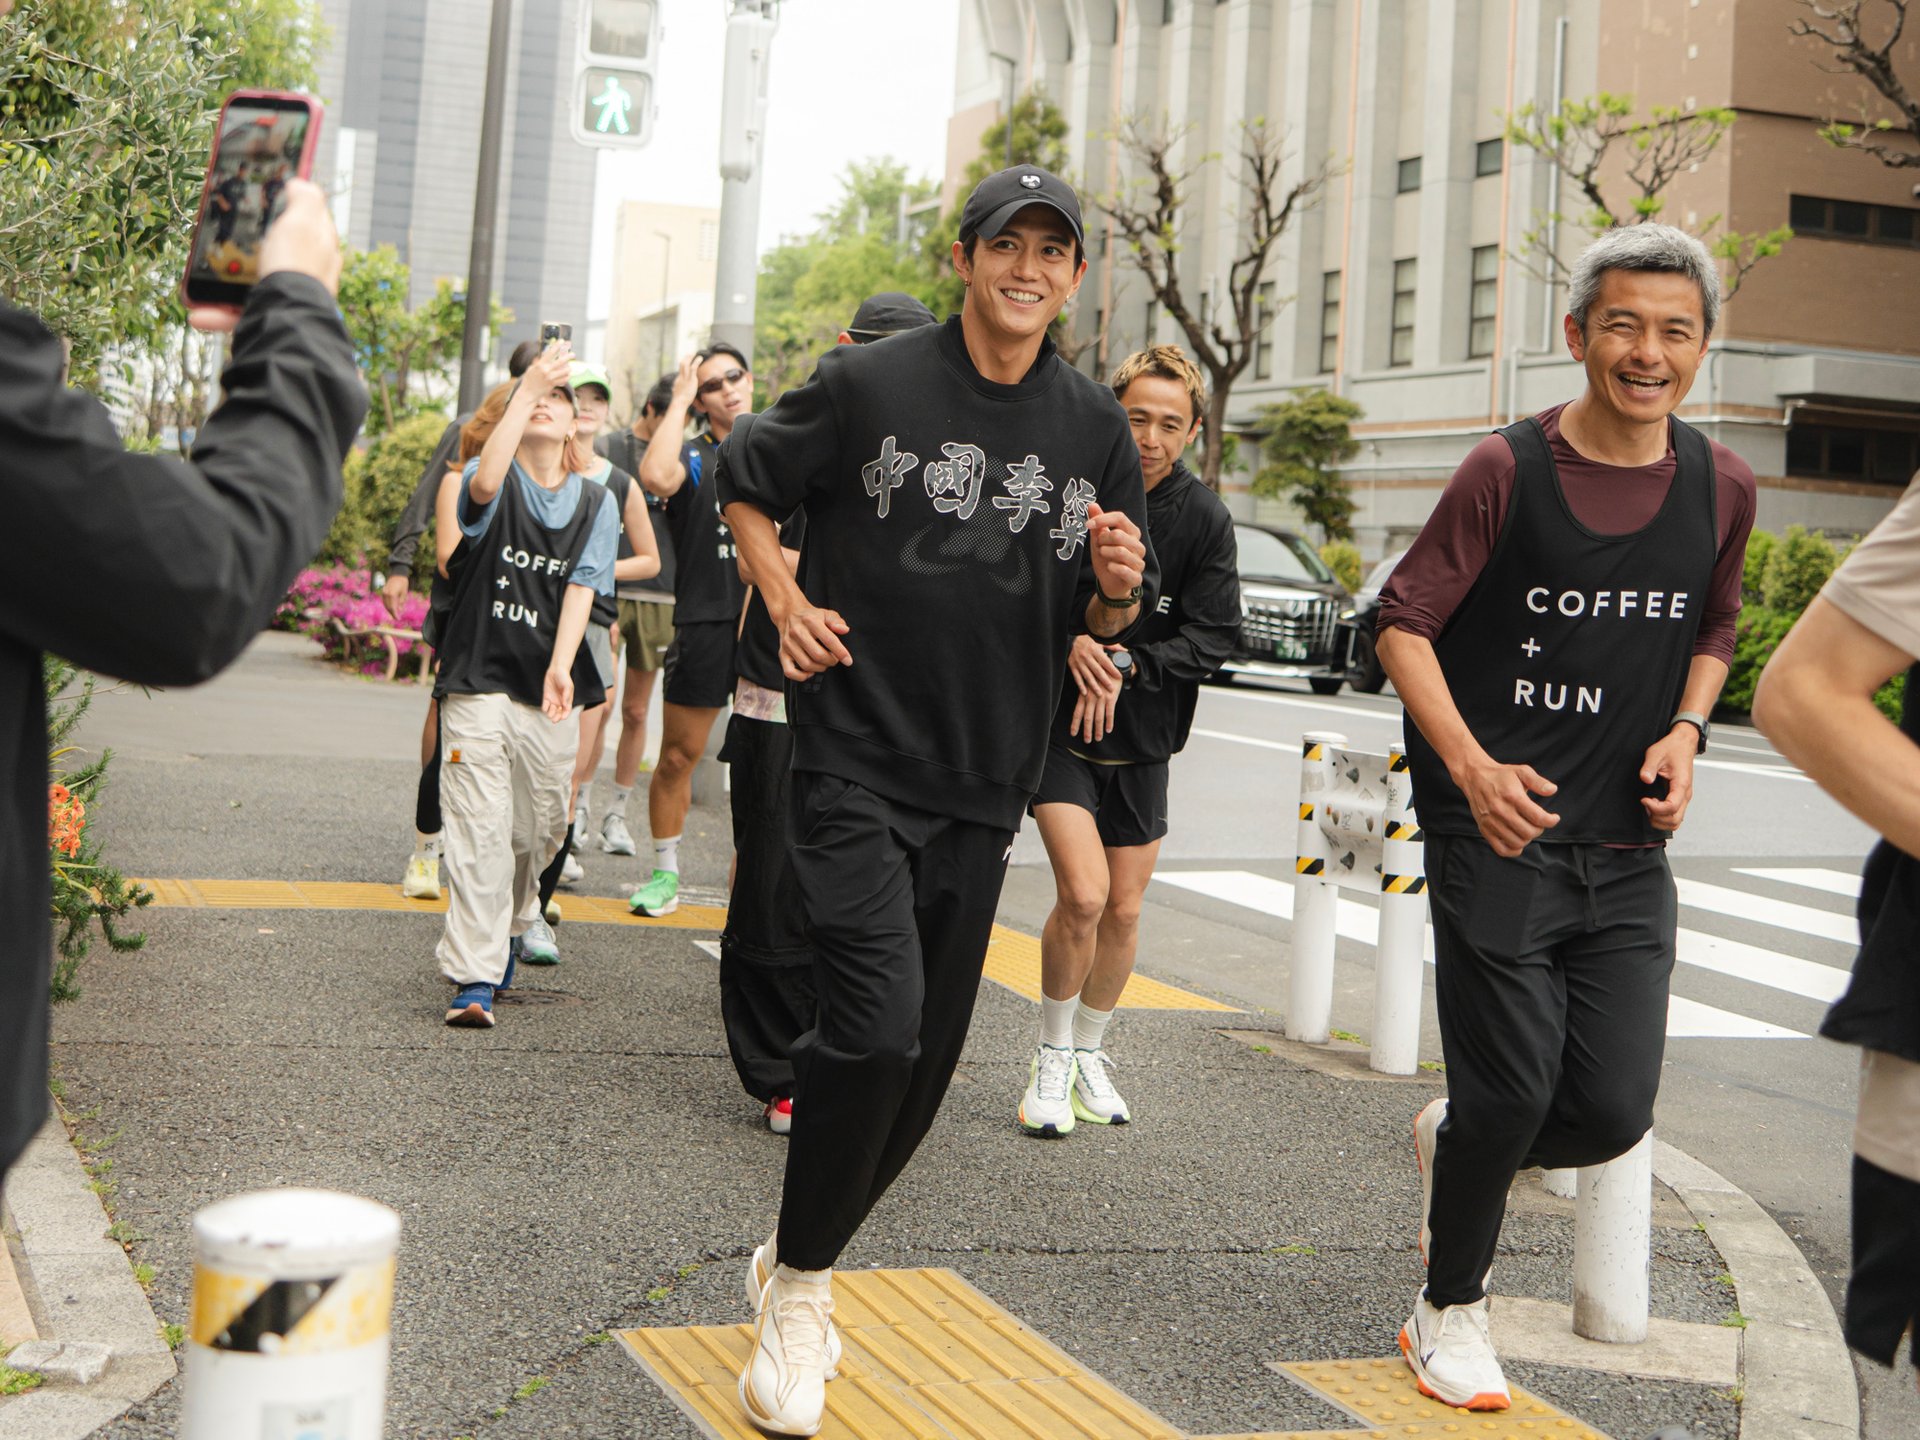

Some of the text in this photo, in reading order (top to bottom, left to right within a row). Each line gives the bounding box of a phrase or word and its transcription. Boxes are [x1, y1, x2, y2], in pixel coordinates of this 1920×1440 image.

[501, 544, 570, 577] COFFE
[717, 543, 737, 559] RU
[492, 600, 539, 628] RUN
[1526, 587, 1688, 619] COFFEE
[1521, 637, 1541, 658] +
[1514, 678, 1602, 714] RUN
